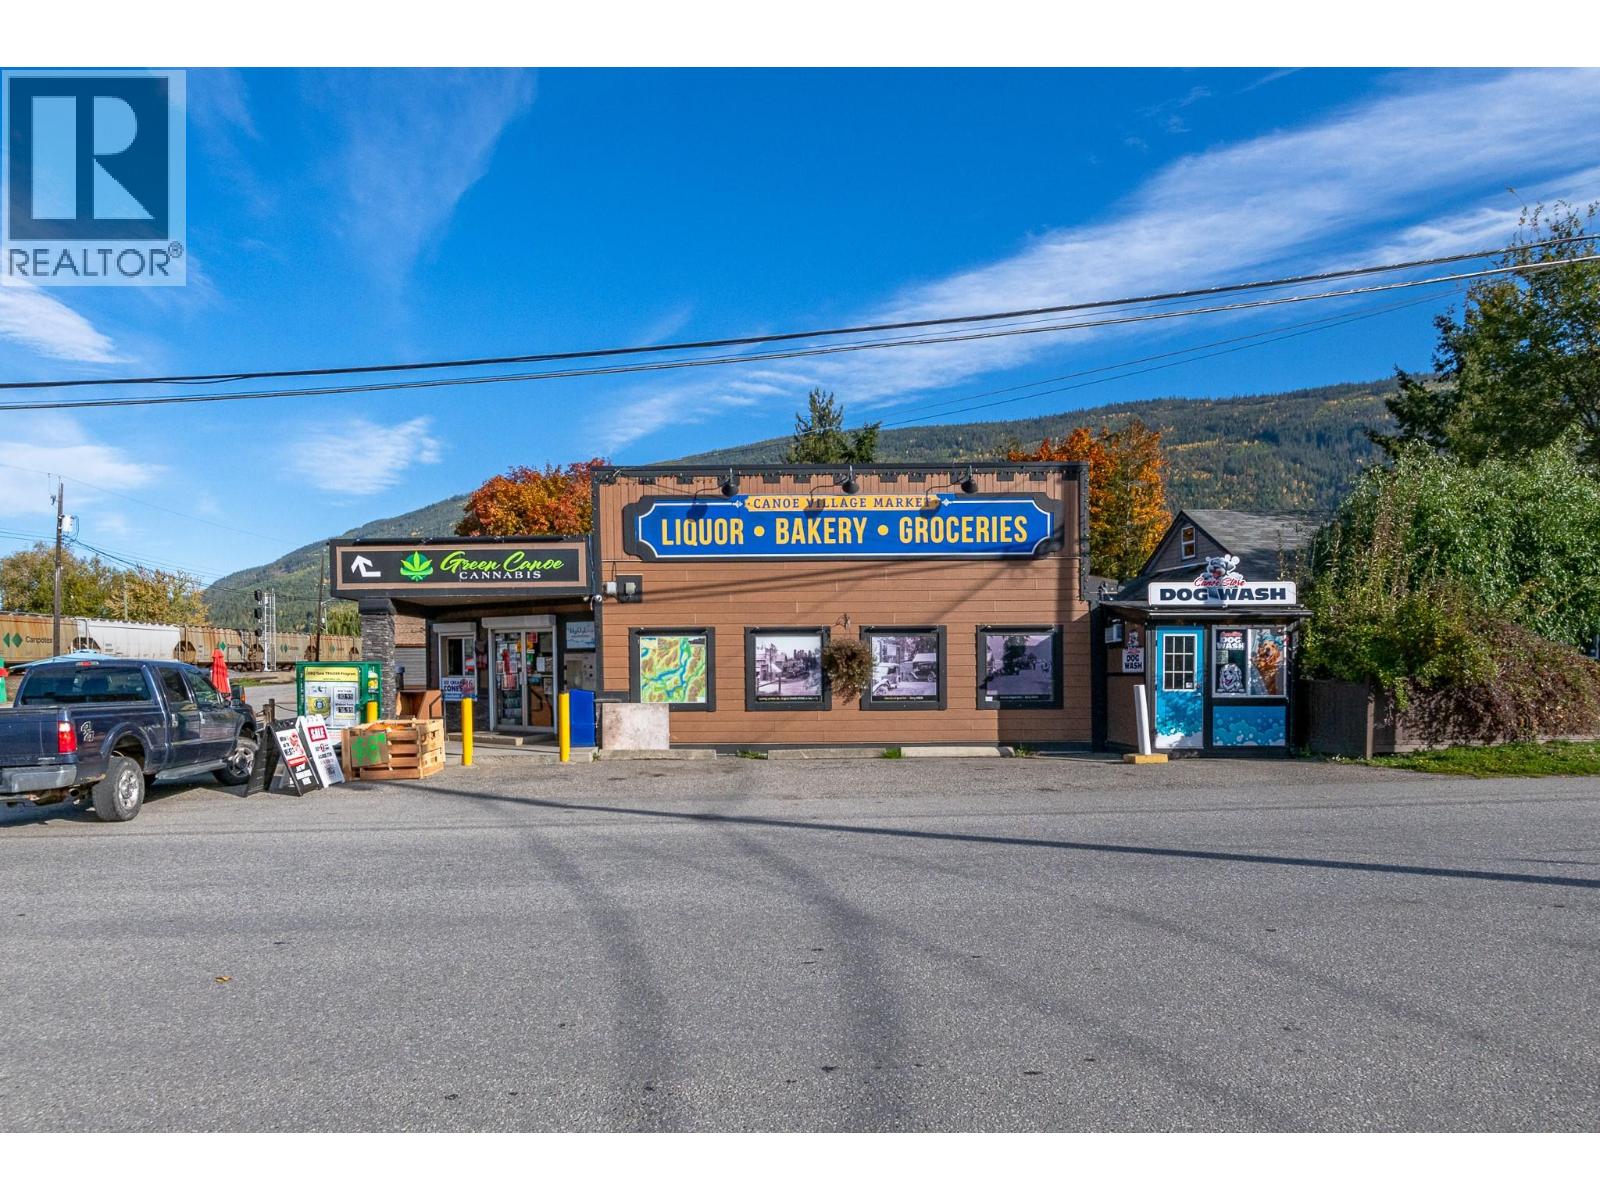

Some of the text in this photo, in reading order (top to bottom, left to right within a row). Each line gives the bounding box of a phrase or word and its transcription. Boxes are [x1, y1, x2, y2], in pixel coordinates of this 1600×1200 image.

[753, 497, 932, 508] CANOE VILLAGE MARKET
[661, 515, 1028, 546] LIQUOR BAKERY GROCERIES
[440, 551, 564, 574] Green Canoe
[459, 570, 541, 580] CANNABIS
[1221, 576, 1246, 587] Store
[1159, 588, 1286, 601] DOG WASH
[1216, 642, 1245, 650] WASH
[1126, 654, 1140, 662] DOG
[1124, 662, 1143, 670] WASH
